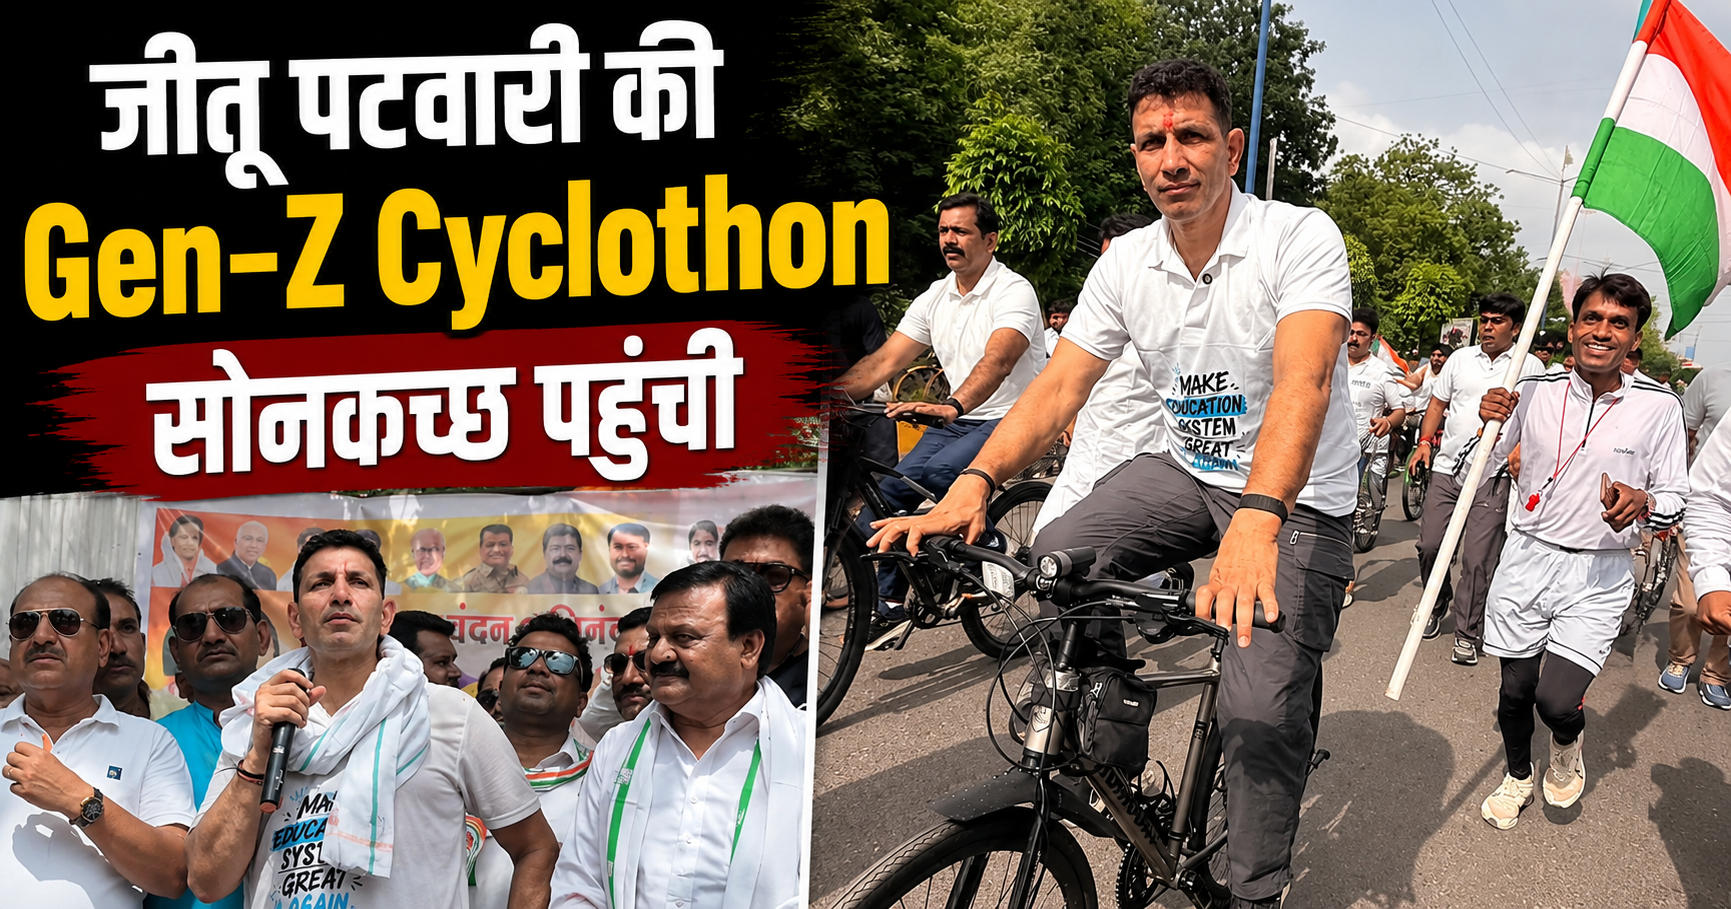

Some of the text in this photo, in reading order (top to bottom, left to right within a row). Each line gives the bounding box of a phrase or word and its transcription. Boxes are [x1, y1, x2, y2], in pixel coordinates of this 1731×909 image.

[1179, 371, 1229, 396] MAKE
[1171, 394, 1243, 415] DUCATION
[1185, 437, 1233, 457] GREAT
[282, 866, 346, 899] GREAT
